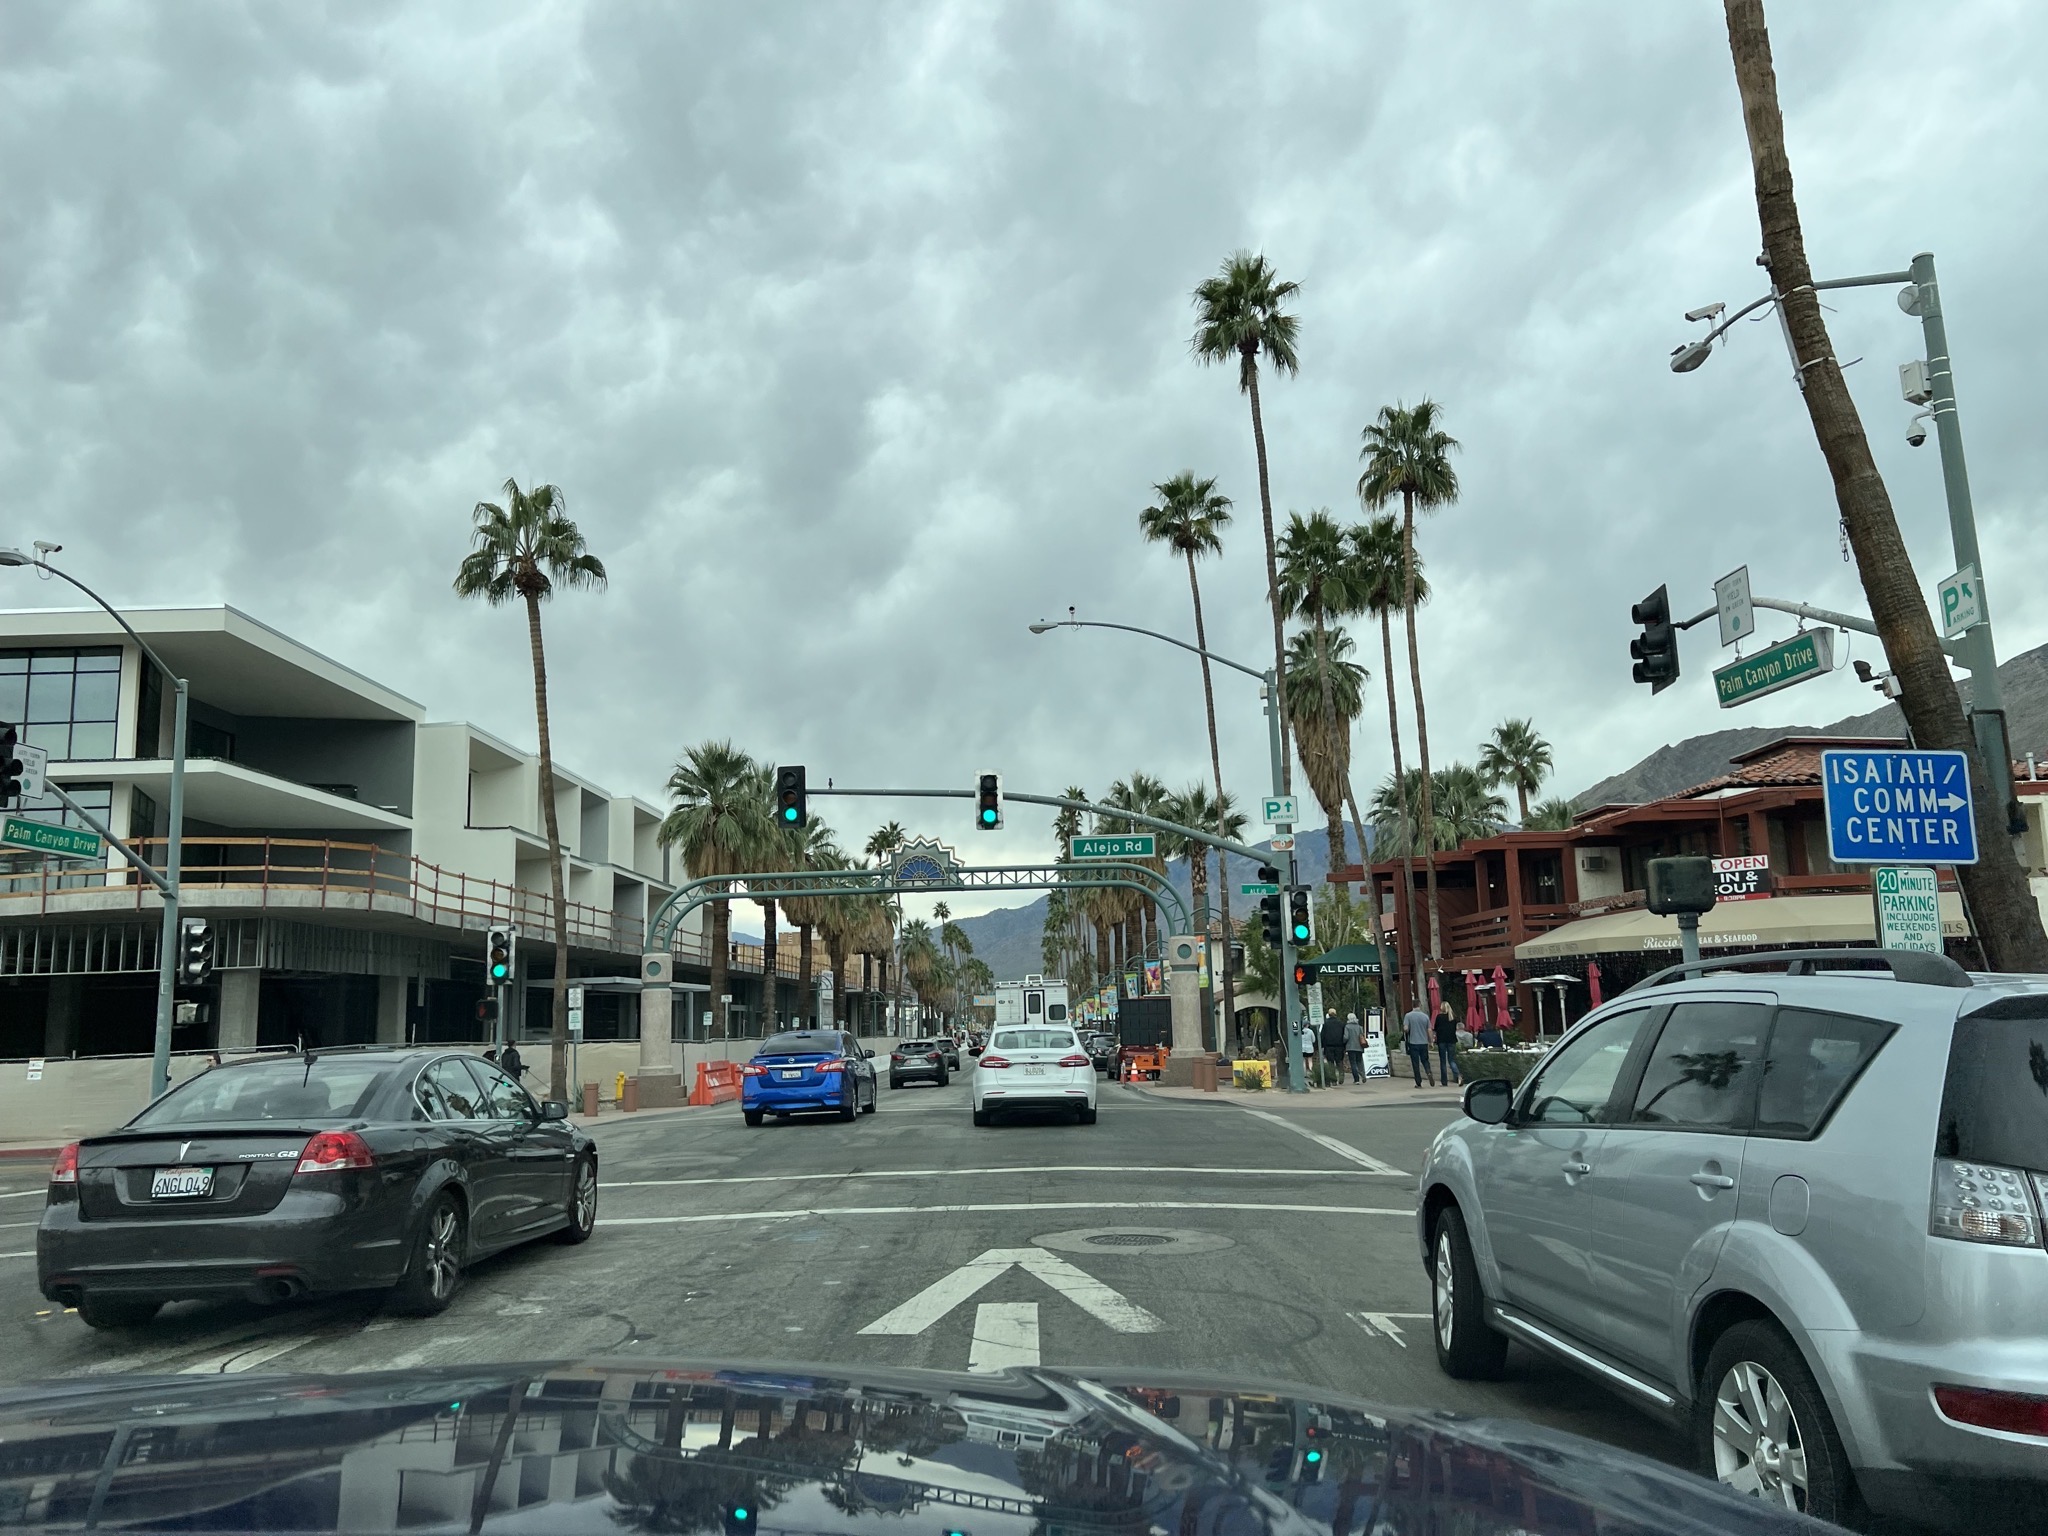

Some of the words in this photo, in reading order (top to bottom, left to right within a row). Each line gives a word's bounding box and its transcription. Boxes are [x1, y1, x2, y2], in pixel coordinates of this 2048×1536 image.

[1719, 675, 1744, 696] Palm
[1745, 659, 1782, 684] Canyon
[1783, 646, 1813, 671] Drive
[1853, 787, 1939, 814] COMM
[7, 824, 31, 841] Palm
[35, 829, 70, 848] Canyon
[73, 836, 97, 852] Drive
[1846, 817, 1960, 845] CENTER
[1082, 842, 1120, 856] Alejo
[1126, 840, 1142, 852] Rd
[1720, 857, 1766, 871] OPEN
[1720, 872, 1740, 884] IN
[1745, 871, 1759, 882] &
[1878, 871, 1898, 891] 20
[1900, 877, 1934, 891] MINUTE
[1883, 895, 1935, 912] PARKING
[1886, 912, 1935, 922] INCLUDING
[1886, 922, 1937, 932] WEEKENDS
[1698, 936, 1713, 945] EAK
[1714, 934, 1721, 944] &
[1722, 933, 1758, 943] SEAFOOD
[1903, 932, 1923, 941] AND
[1890, 942, 1937, 951] HOLIDAYS
[1320, 965, 1335, 973] AL
[1337, 964, 1380, 973] DENTE
[277, 1150, 299, 1158] G8
[153, 1176, 210, 1195] 6NGL049
